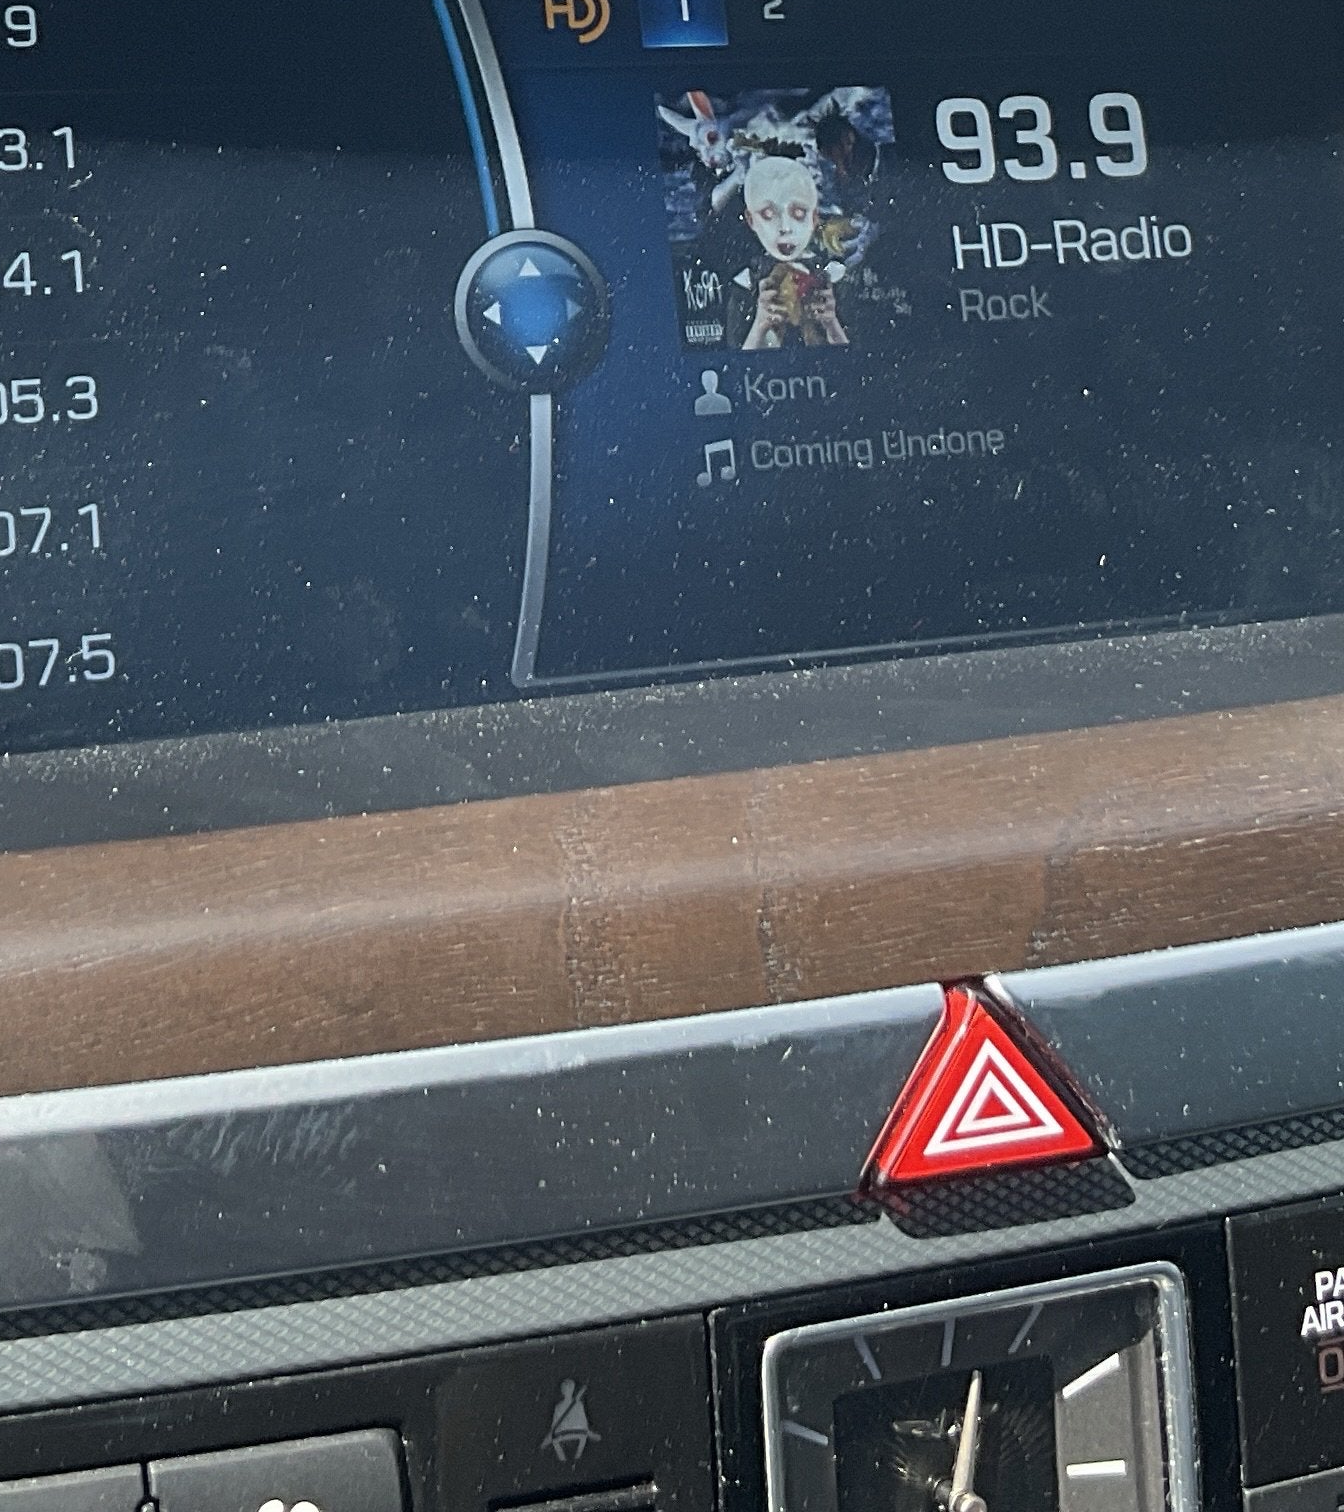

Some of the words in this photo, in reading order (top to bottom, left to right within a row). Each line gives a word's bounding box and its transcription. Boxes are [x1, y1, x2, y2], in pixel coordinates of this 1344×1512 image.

[936, 93, 1147, 182] 93.9
[953, 217, 1192, 269] HD-Radio
[960, 286, 1051, 321] Rock
[745, 372, 827, 404] Korn
[751, 436, 872, 469] Coming
[883, 427, 1004, 461] Undone
